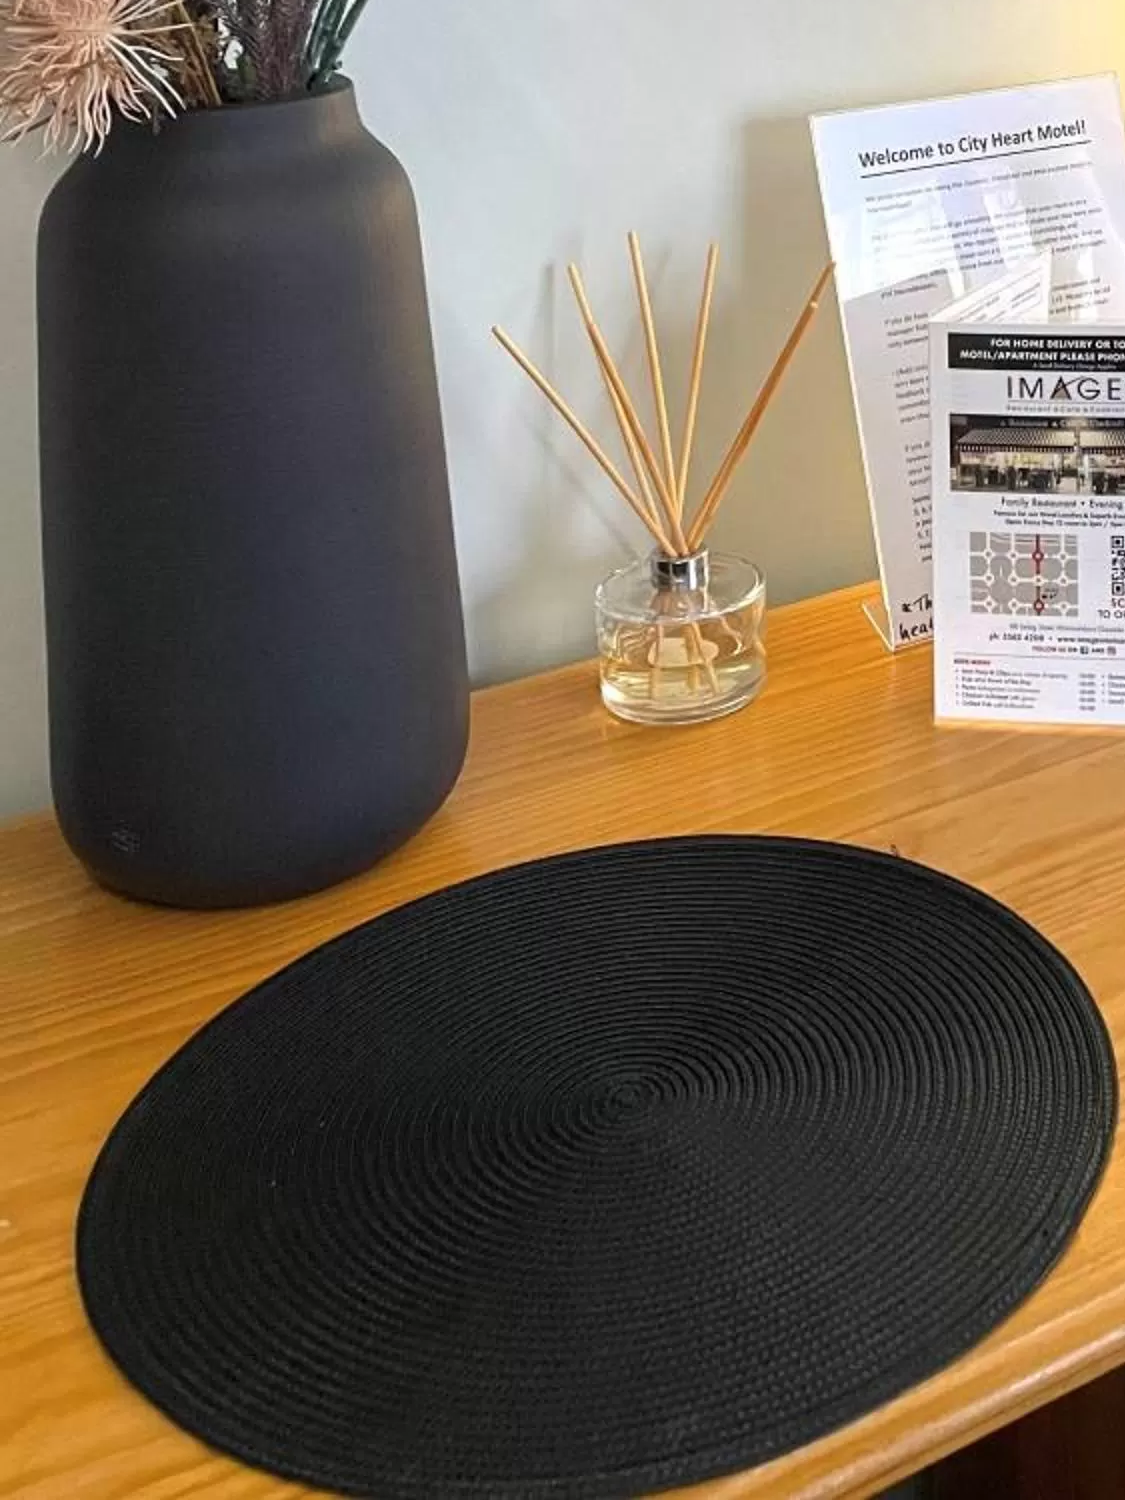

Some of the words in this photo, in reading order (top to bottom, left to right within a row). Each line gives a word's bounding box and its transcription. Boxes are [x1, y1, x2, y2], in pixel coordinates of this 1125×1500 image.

[858, 145, 935, 169] Welcome
[939, 141, 955, 157] to
[958, 135, 988, 154] City
[991, 128, 1034, 148] Heart
[1037, 119, 1086, 141] Motel!
[990, 338, 1011, 348] FOR
[1013, 339, 1045, 348] HOME
[1046, 339, 1094, 349] DELIVERY
[1095, 339, 1111, 349] OR
[960, 349, 1058, 361] MOTEL/APARTMENT
[1059, 351, 1095, 361] PLEASE
[1001, 496, 1028, 508] Family
[1031, 497, 1077, 507] Restaurant
[1089, 499, 1123, 510] Evening
